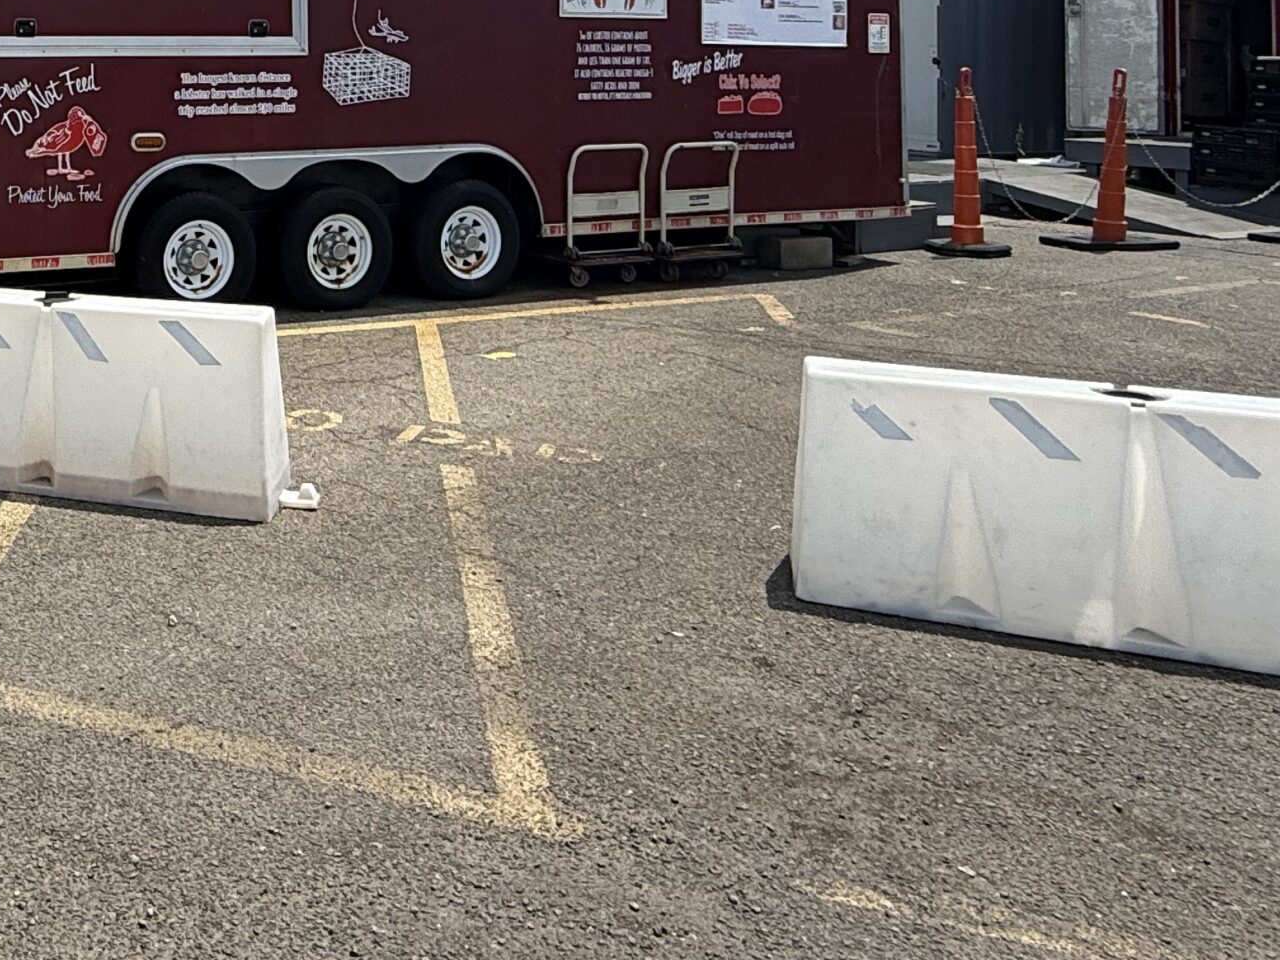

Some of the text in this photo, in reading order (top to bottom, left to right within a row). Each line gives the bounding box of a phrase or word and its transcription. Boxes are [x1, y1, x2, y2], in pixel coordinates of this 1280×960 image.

[672, 60, 702, 85] Bigger
[703, 55, 712, 74] is
[713, 48, 743, 72] Better
[1, 63, 101, 136] Do Not Feed
[7, 184, 102, 208] Protect Your Food
